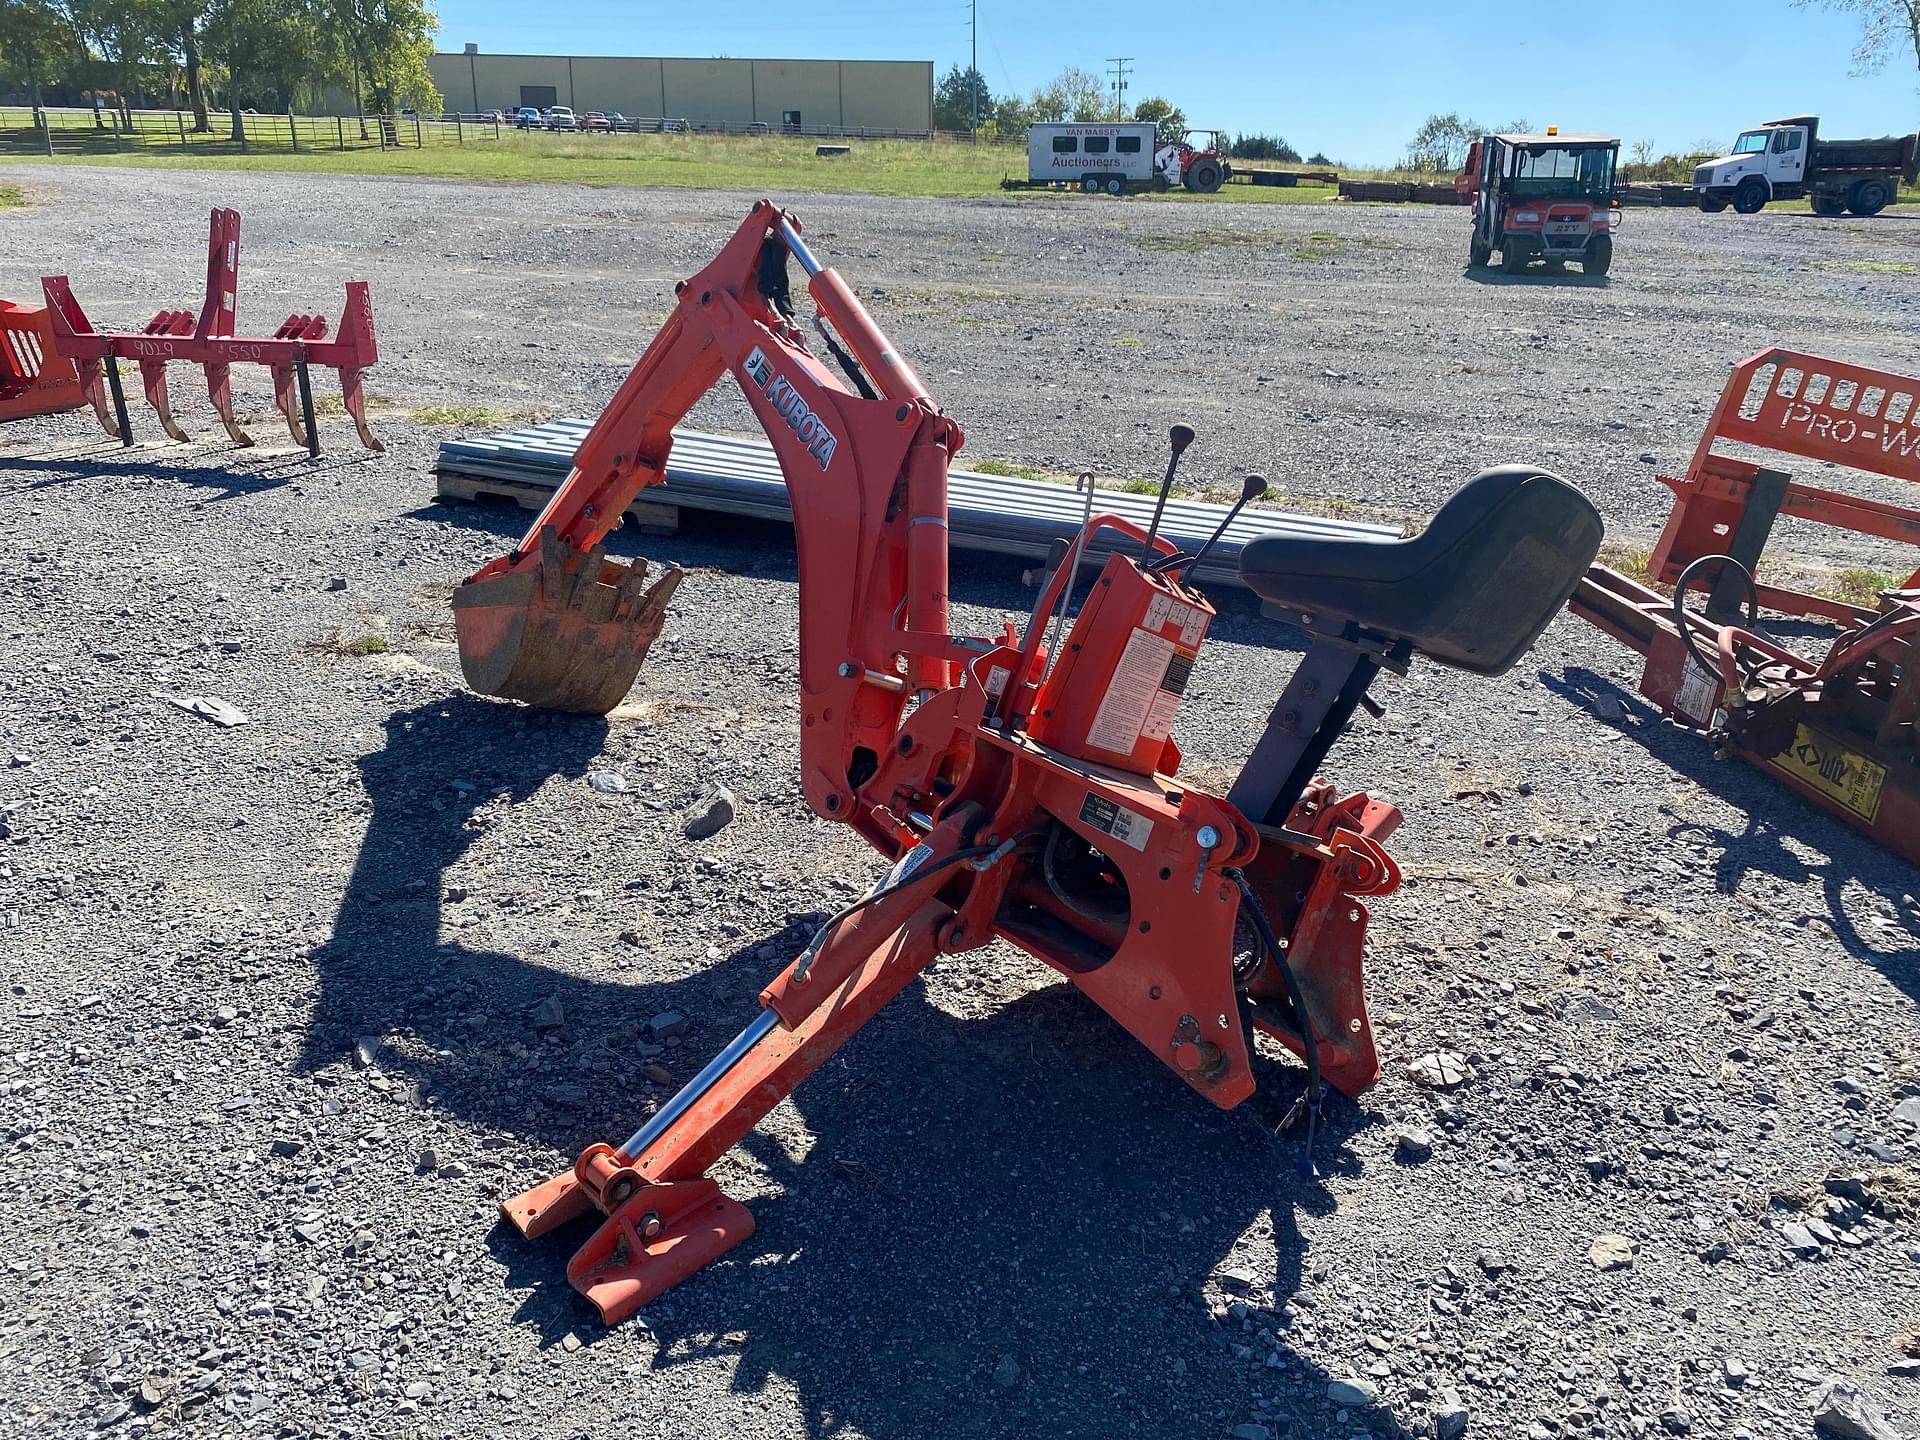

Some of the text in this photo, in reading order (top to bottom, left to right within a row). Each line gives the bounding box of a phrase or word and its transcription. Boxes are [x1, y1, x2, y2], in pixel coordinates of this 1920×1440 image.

[1065, 128, 1121, 136] VAN MASSEY
[1052, 157, 1136, 168] Auctioneers LLC
[765, 374, 837, 471] KUBOTA
[1780, 402, 1920, 459] PRO-W
